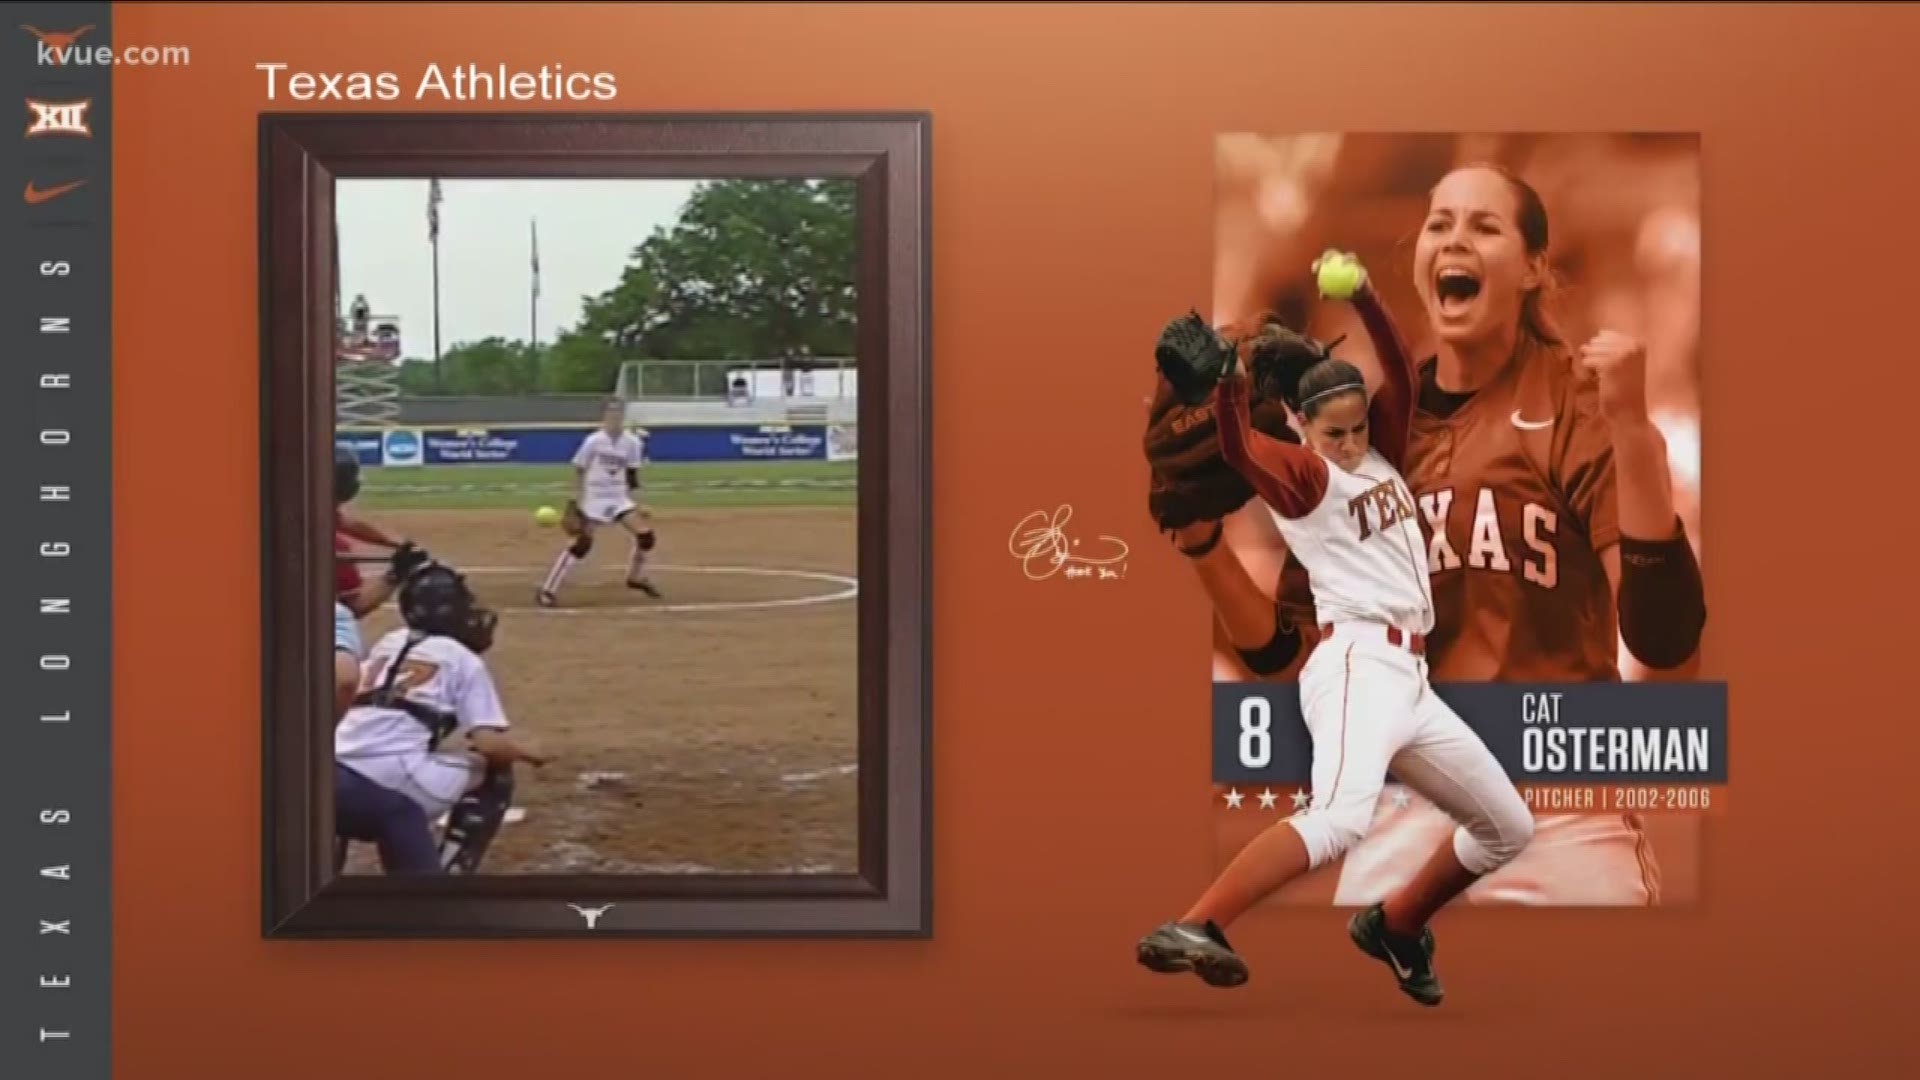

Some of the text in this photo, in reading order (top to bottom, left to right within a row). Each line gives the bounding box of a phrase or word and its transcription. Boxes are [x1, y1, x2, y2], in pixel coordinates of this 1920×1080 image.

[39, 260, 71, 1042] TEXAS LONGHORNS
[1522, 692, 1563, 724] CAT
[1239, 696, 1272, 768] 8
[1522, 727, 1709, 772] OSTERMAN
[1524, 787, 1711, 810] PITCHER 2002-2006
